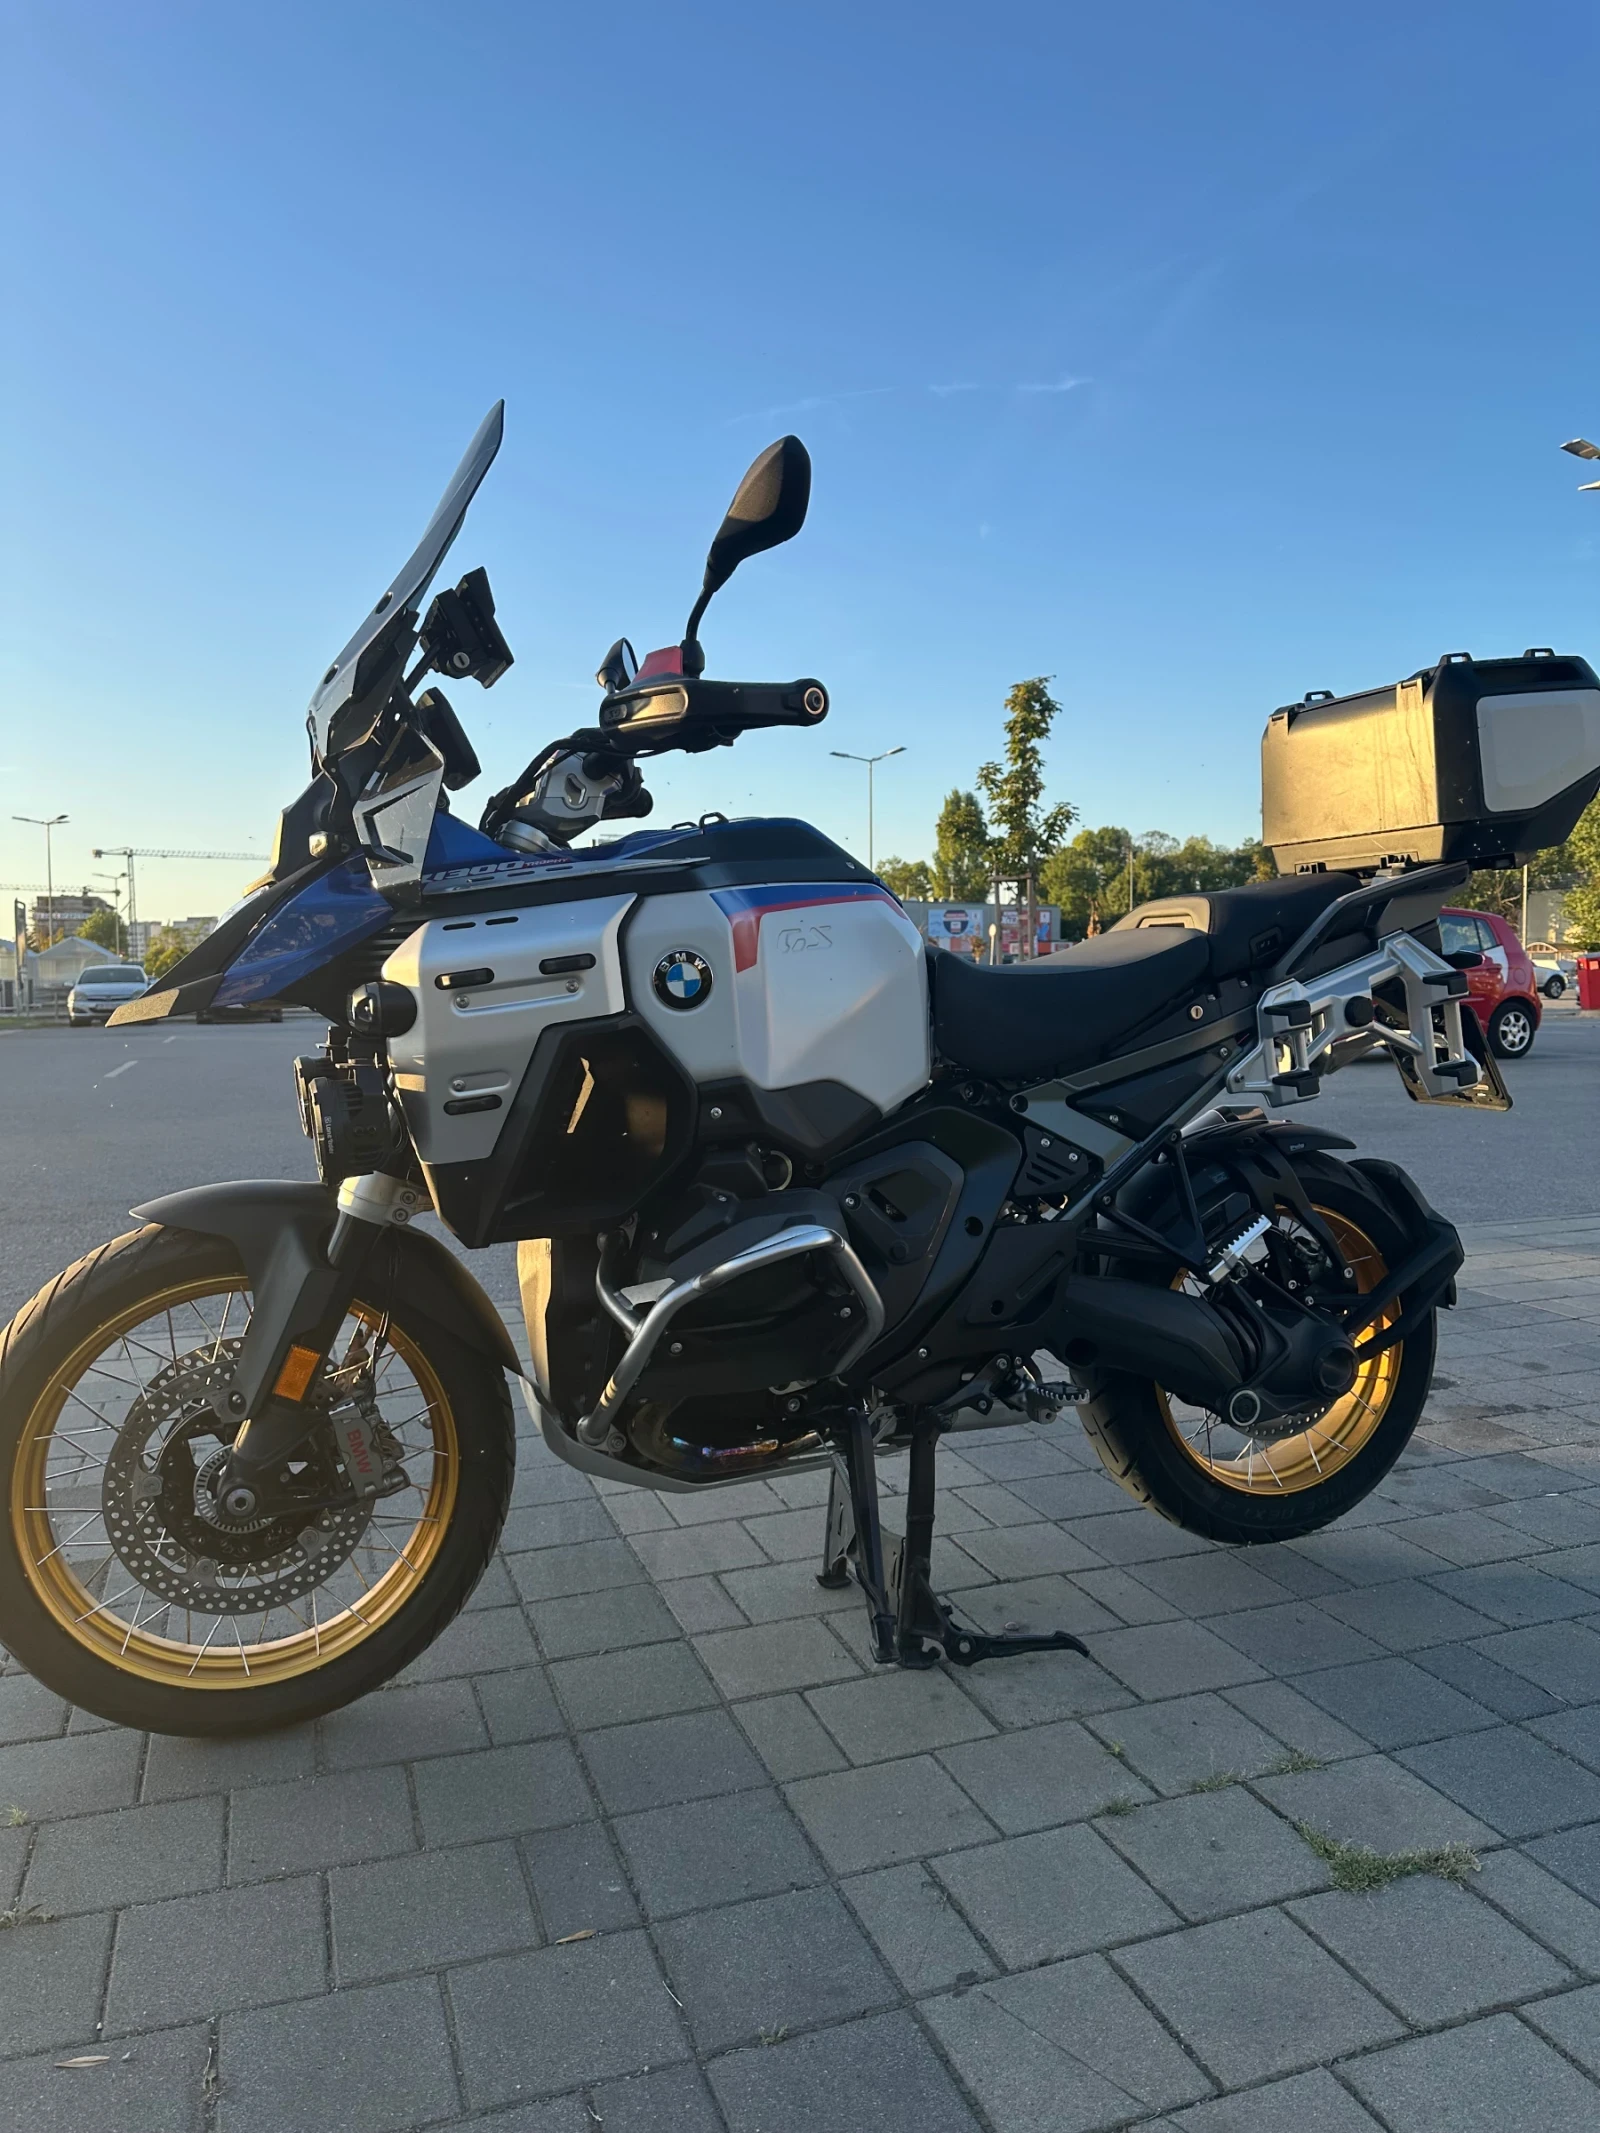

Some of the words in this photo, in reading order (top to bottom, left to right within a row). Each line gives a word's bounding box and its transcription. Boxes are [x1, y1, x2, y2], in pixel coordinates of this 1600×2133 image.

[526, 858, 569, 867] TROPHY
[777, 925, 833, 954] GS
[658, 952, 707, 972] BMW
[347, 1428, 373, 1473] BMW
